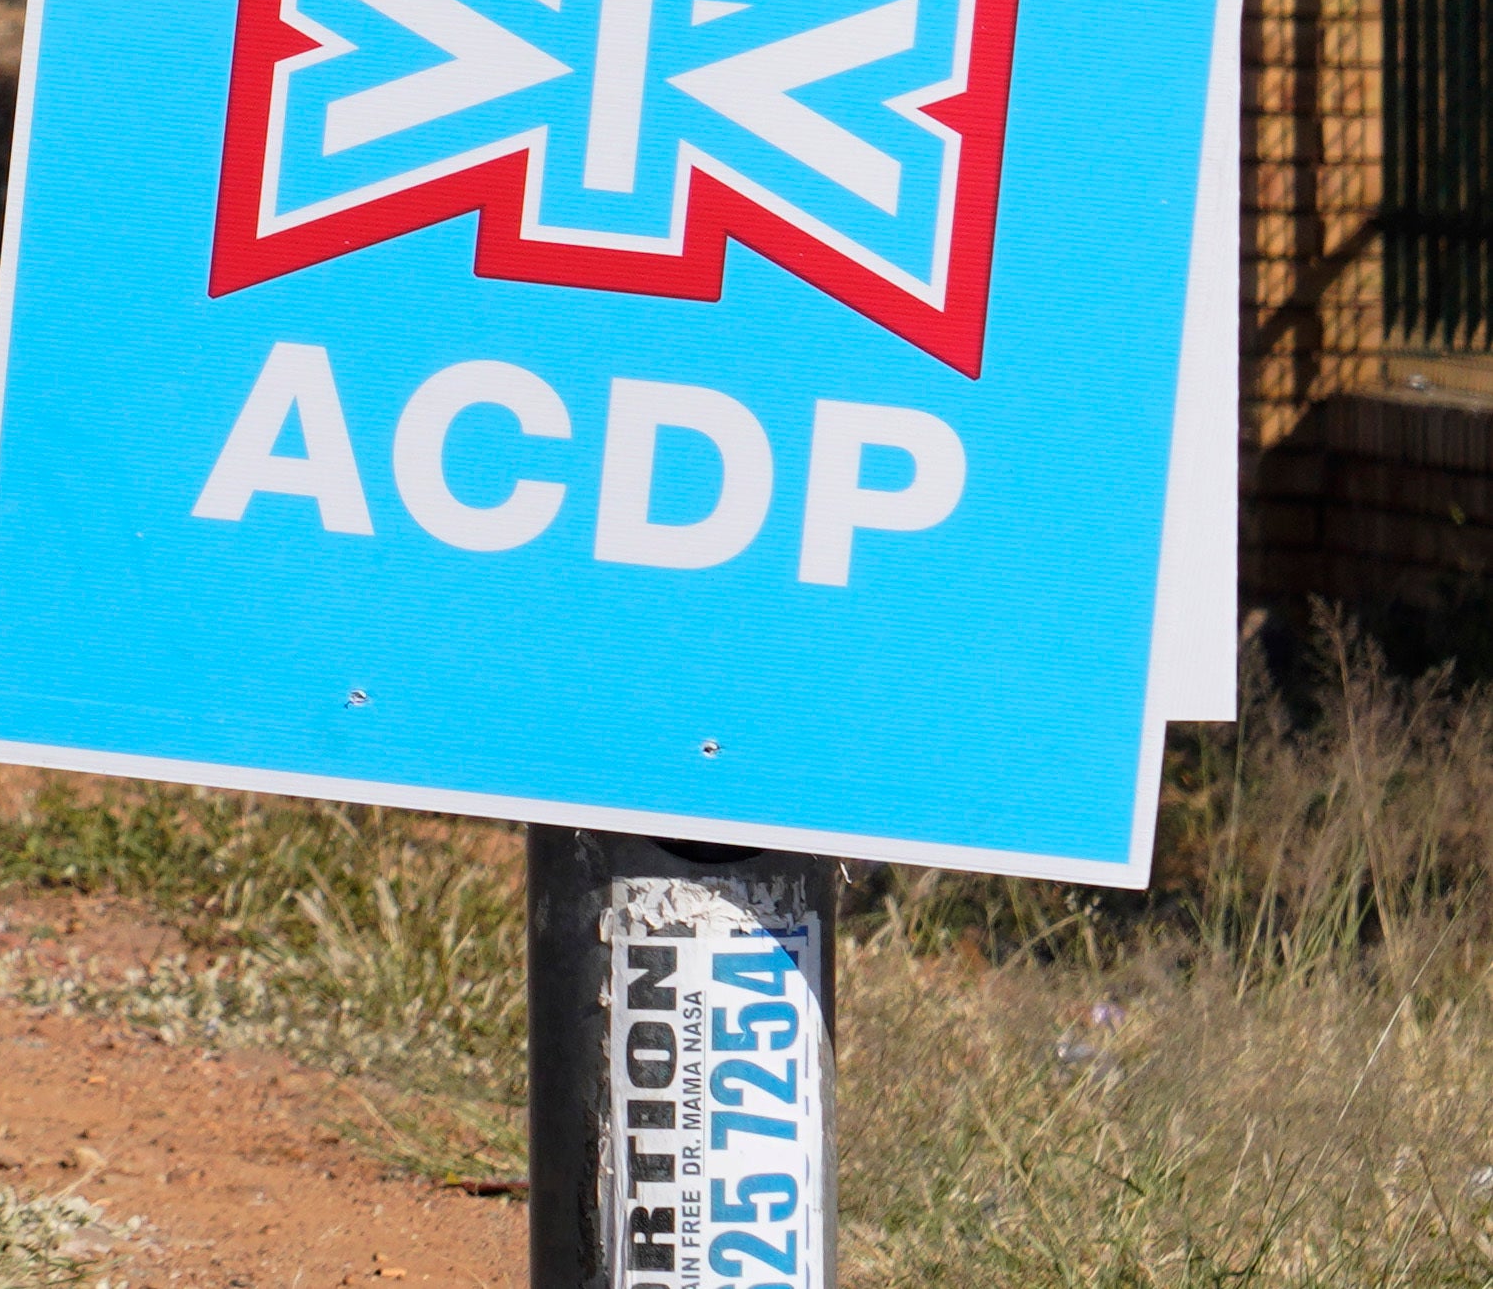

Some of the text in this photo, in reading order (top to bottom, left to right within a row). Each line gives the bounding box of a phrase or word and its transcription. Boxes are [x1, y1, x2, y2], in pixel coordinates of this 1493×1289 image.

[190, 342, 967, 589] ACDP
[682, 990, 704, 1049] NASA
[626, 945, 678, 1289] RTION
[681, 1061, 703, 1131] MAMA
[708, 951, 800, 1289] 25 7254
[681, 1137, 703, 1177] DR.
[680, 1189, 702, 1244] FREE
